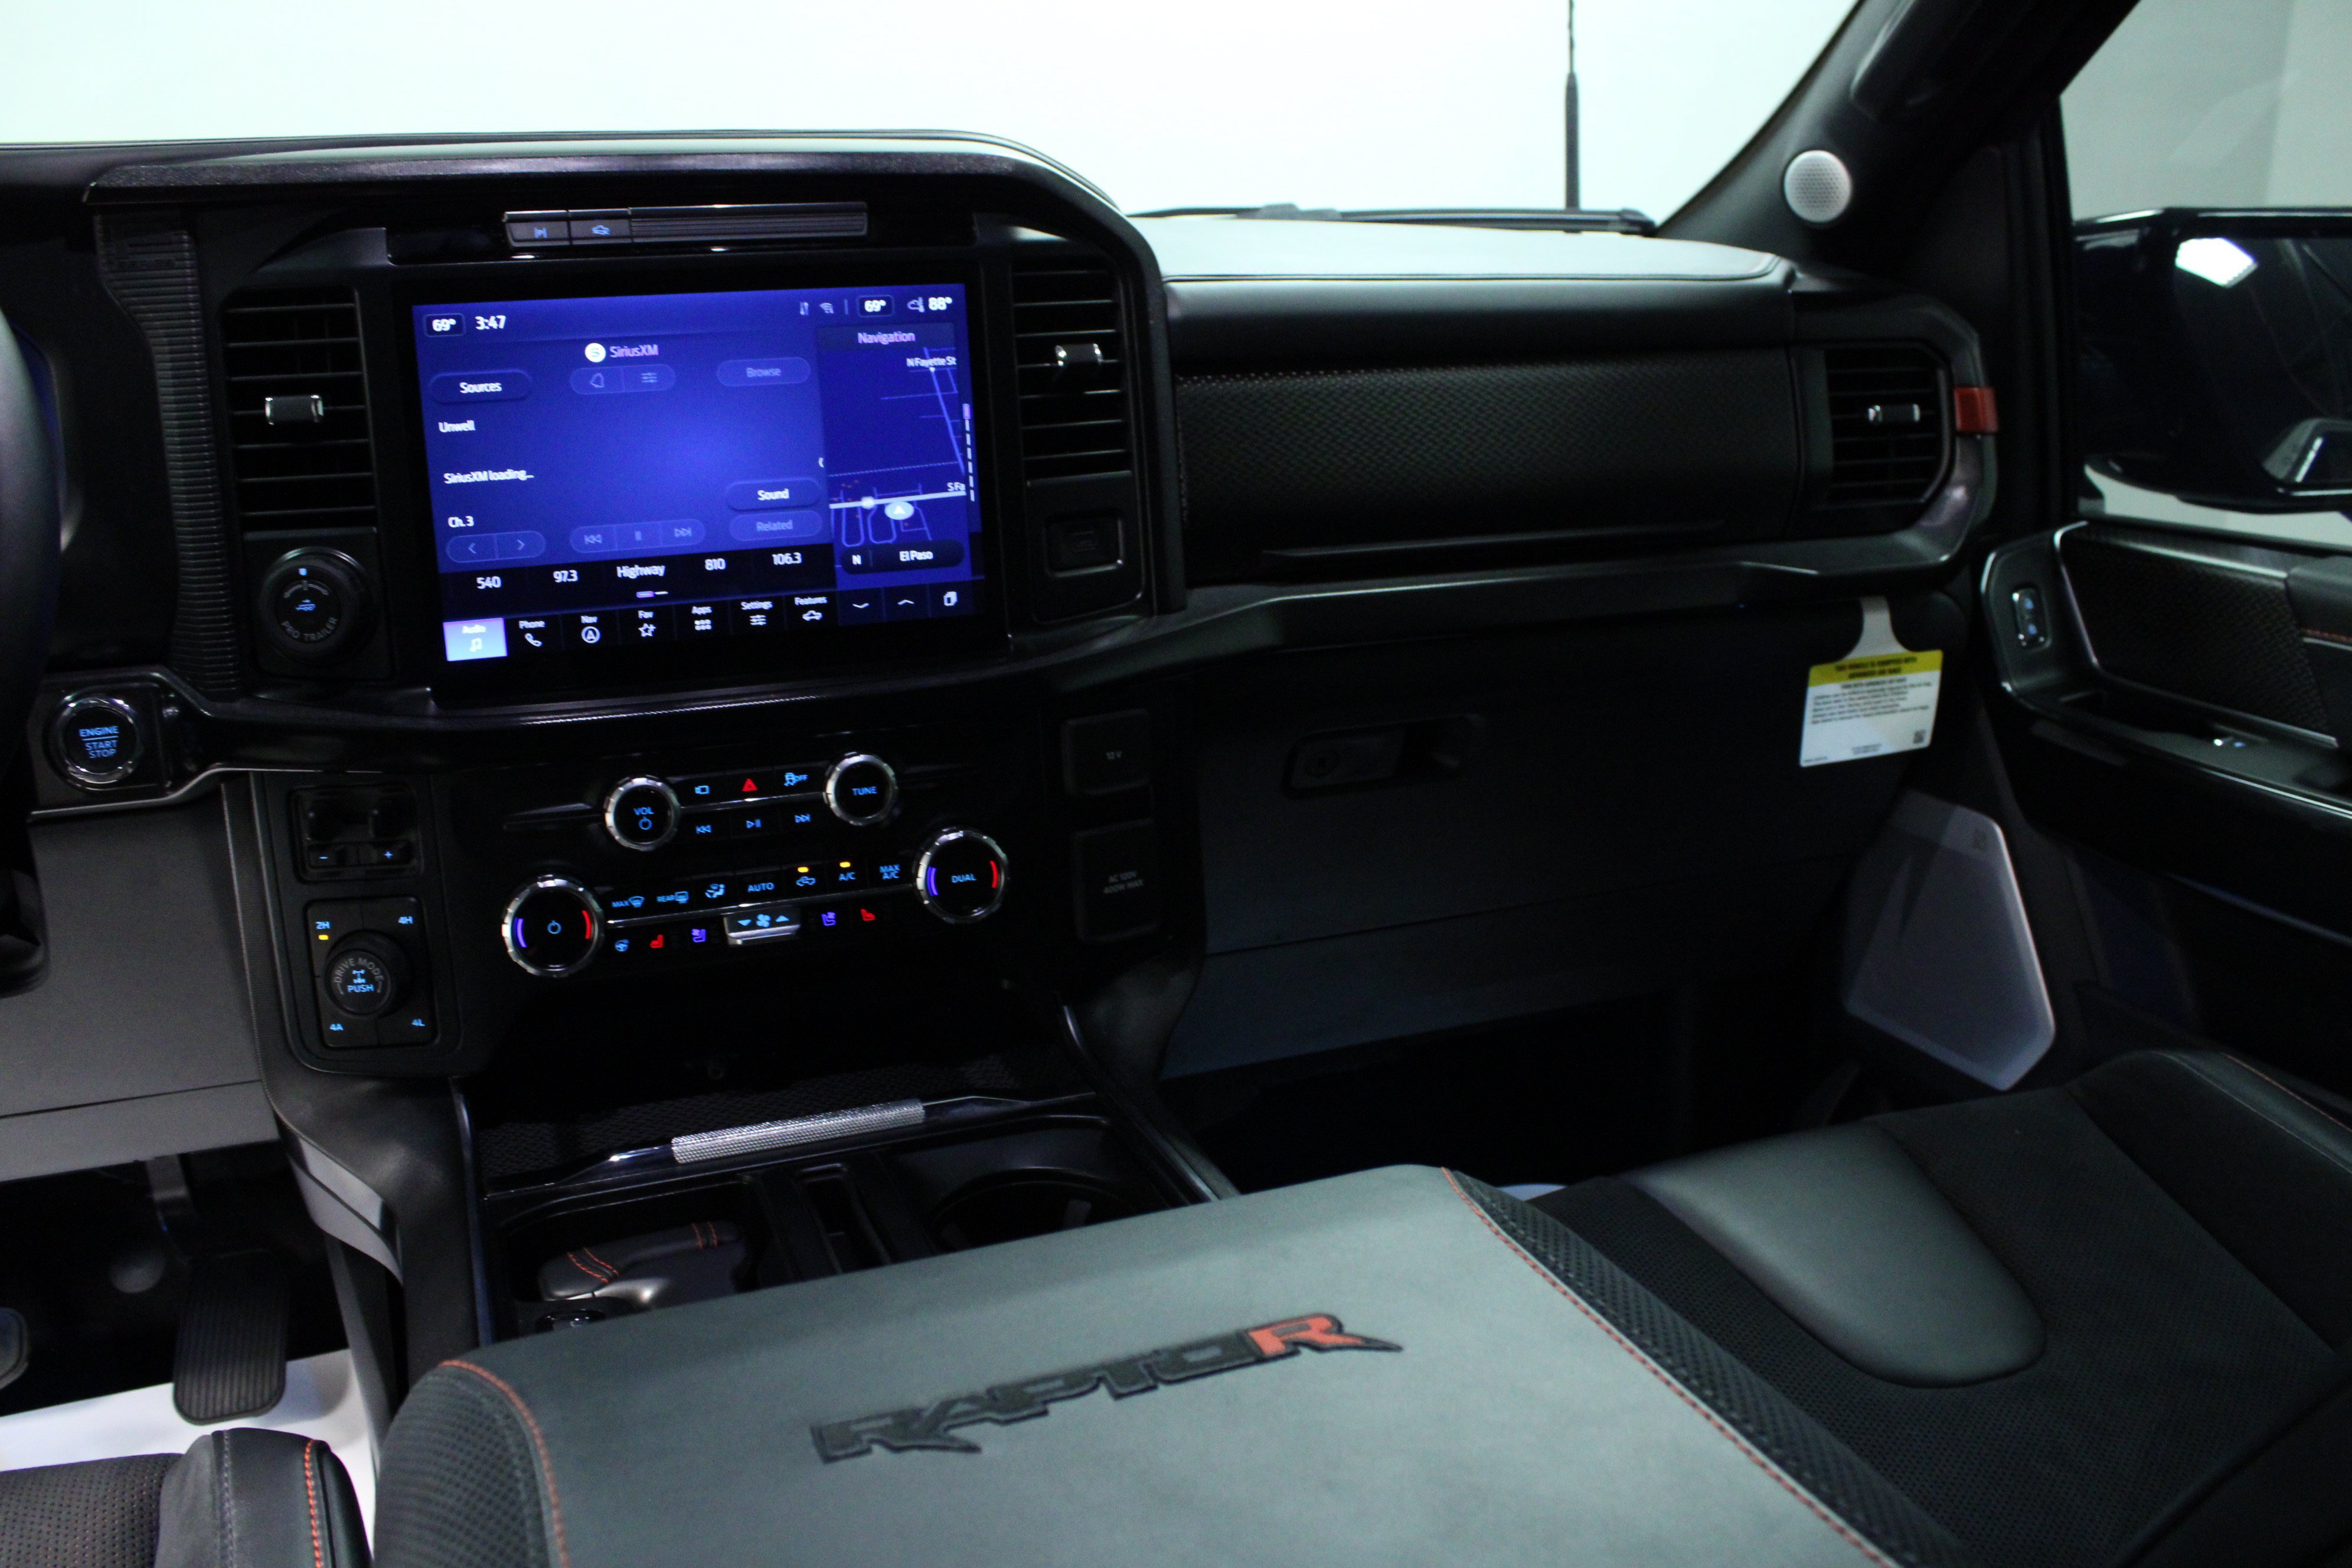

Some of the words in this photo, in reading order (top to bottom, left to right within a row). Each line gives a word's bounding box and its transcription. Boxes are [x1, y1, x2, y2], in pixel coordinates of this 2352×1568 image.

[432, 318, 456, 332] 69°
[474, 315, 506, 330] 3:47
[857, 331, 916, 345] Navigation
[609, 344, 659, 358] SiriusXM
[746, 367, 782, 378] Browse
[459, 381, 502, 394] Sources
[438, 420, 476, 433] Unwell
[443, 471, 489, 484] SiriusXM
[757, 488, 790, 501] Sound
[756, 519, 793, 531] Related
[772, 552, 802, 565] 106.3
[852, 555, 861, 565] N
[899, 551, 910, 561] El
[909, 550, 934, 560] Paso
[704, 558, 727, 571] 810
[553, 570, 579, 583] 97.3
[616, 564, 666, 579] Highway
[476, 576, 501, 589] 540
[741, 600, 773, 610] Settings
[794, 596, 828, 606] Features
[519, 620, 545, 629] Phone
[79, 726, 120, 737] ENGINE
[85, 740, 117, 751] START
[89, 749, 117, 759] STOP
[851, 786, 878, 796] TUNE
[633, 806, 655, 816] VOL
[879, 864, 900, 874] MAX
[838, 872, 856, 881] A/C
[881, 871, 900, 880] A/C
[951, 873, 977, 883] DUAL
[747, 883, 775, 892] AUTO
[315, 921, 331, 929] 2H
[397, 916, 413, 925] 4H
[334, 958, 355, 984] DRIVE
[357, 957, 384, 982] MODE
[347, 984, 375, 993] PUSH
[329, 1023, 344, 1031] 4A
[411, 1018, 426, 1027] 4L
[811, 1312, 1402, 1466] RAPTOR
